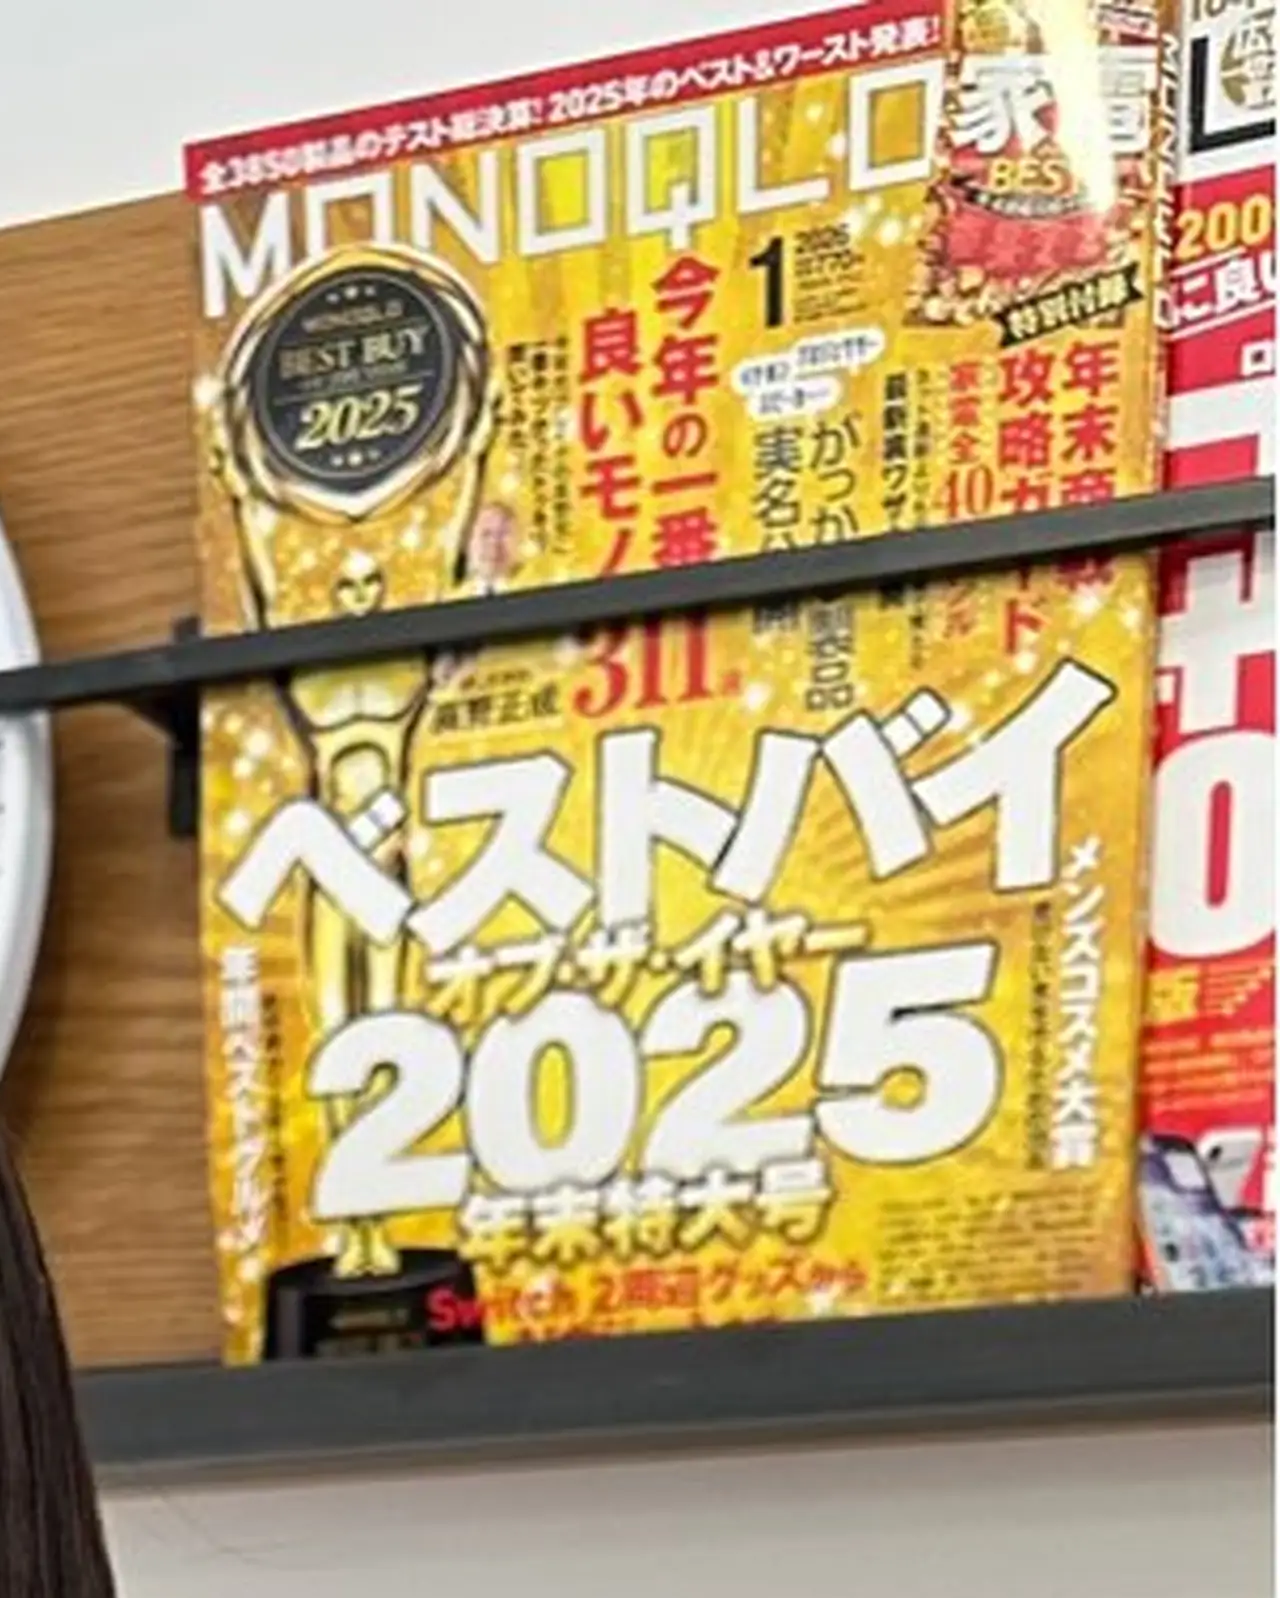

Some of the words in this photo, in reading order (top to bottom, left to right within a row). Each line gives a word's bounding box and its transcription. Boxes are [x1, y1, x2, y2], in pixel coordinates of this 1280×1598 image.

[202, 57, 945, 318] MONOQLO
[749, 236, 785, 328] 1
[278, 340, 357, 380] BEST
[362, 325, 429, 364] BUY
[294, 384, 423, 452] 2025
[218, 656, 1117, 960] ベストバイ
[307, 940, 1004, 1223] 2025
[458, 1157, 836, 1276] 年末特大号
